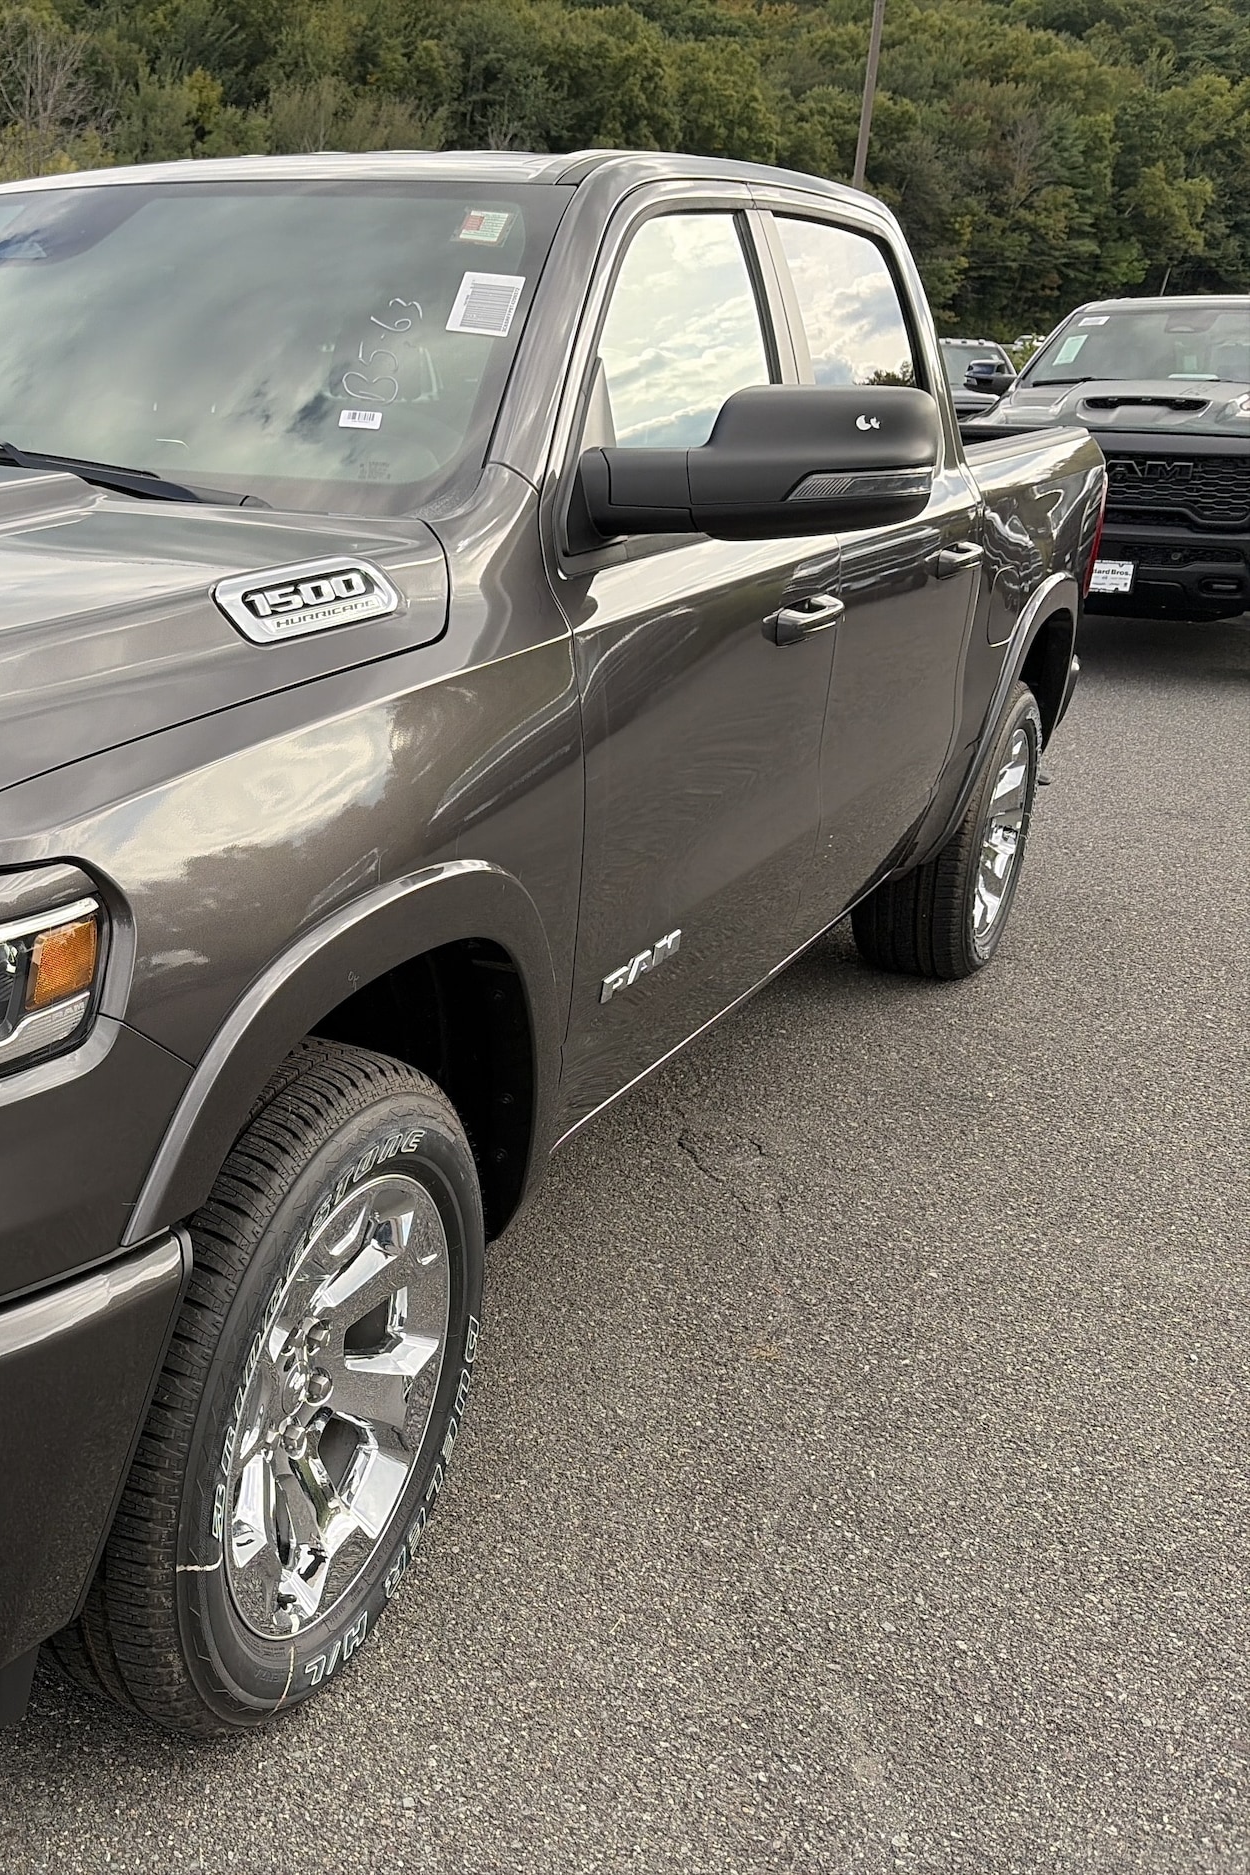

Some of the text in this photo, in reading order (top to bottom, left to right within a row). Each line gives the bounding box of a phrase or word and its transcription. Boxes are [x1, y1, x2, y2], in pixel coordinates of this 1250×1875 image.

[1107, 459, 1194, 479] AM
[244, 571, 367, 617] 1500
[276, 601, 376, 628] HURRICANE
[599, 928, 682, 1004] RAM
